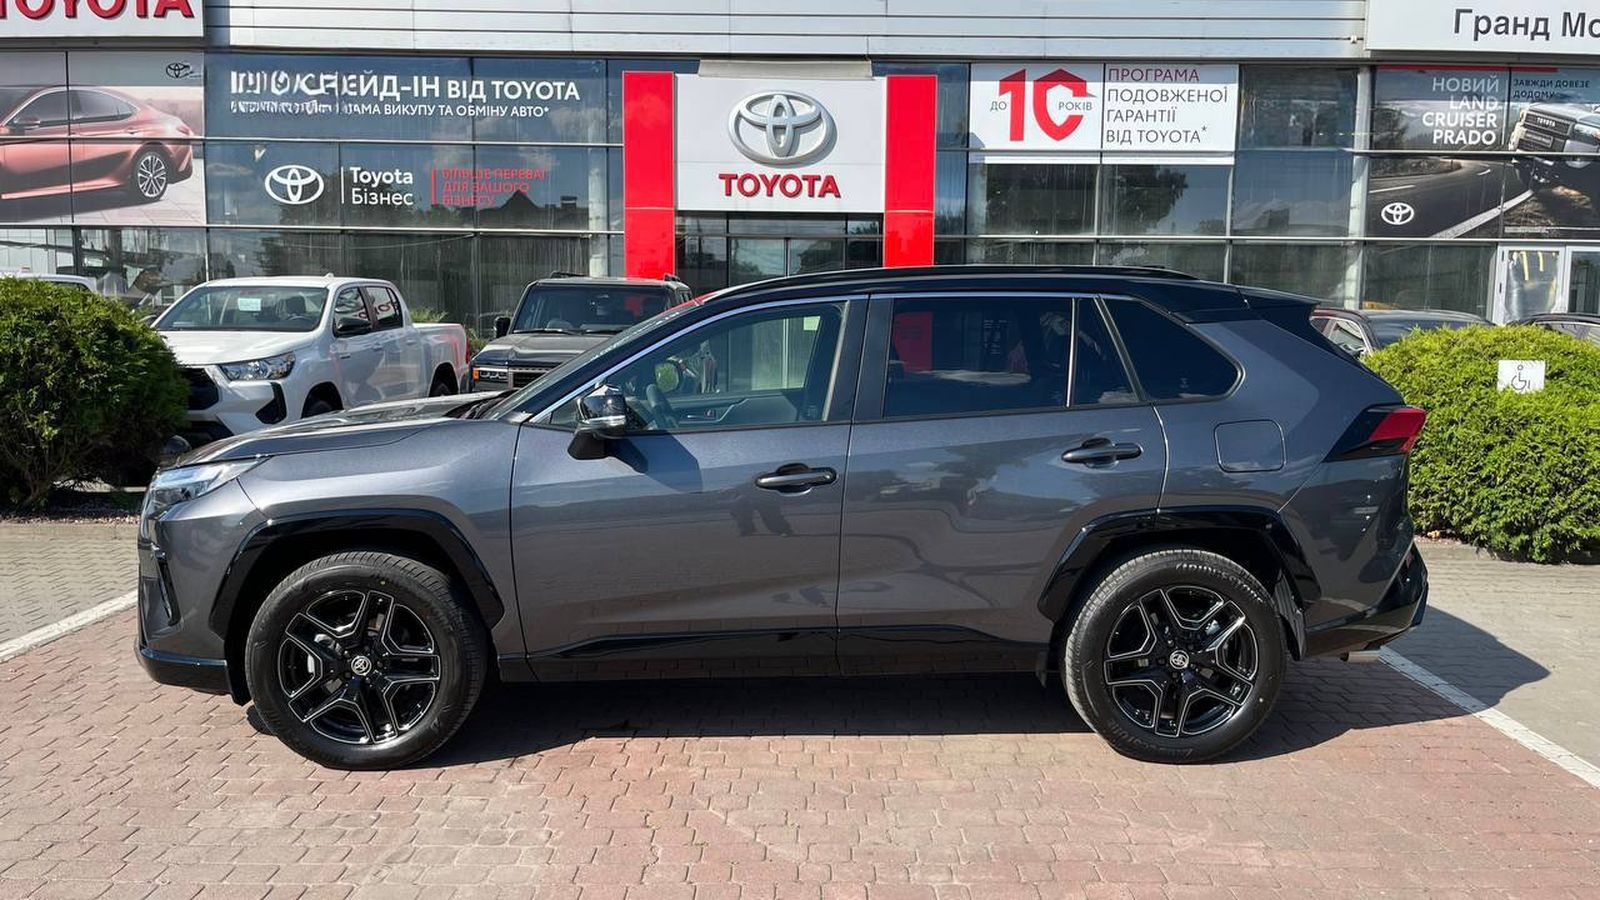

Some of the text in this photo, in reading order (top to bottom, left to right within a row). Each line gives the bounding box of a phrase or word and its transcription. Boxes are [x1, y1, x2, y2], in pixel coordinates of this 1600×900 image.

[1454, 8, 1550, 41] Гранд
[1108, 68, 1200, 82] ПРОГРАМА
[1432, 75, 1500, 93] НОВИЙ
[447, 79, 487, 102] ВІД
[491, 80, 581, 100] TOYOTA
[1107, 86, 1228, 104] ПОДОВЖЕНОЇ
[384, 103, 435, 116] ВИКУПУ
[438, 104, 453, 116] ТА
[456, 105, 508, 117] ОБМІНУ
[990, 101, 1007, 112] ДО
[1058, 101, 1093, 111] РОКІВ
[1449, 95, 1499, 111] LAND
[1106, 105, 1177, 123] ГАРАНТІЇ
[1422, 112, 1497, 128] CRUISER
[1106, 128, 1132, 144] ВІД
[1432, 130, 1496, 145] PRADO
[350, 166, 413, 188] Toyota
[718, 173, 842, 198] TOYOTA
[351, 188, 414, 206] Бізнес
